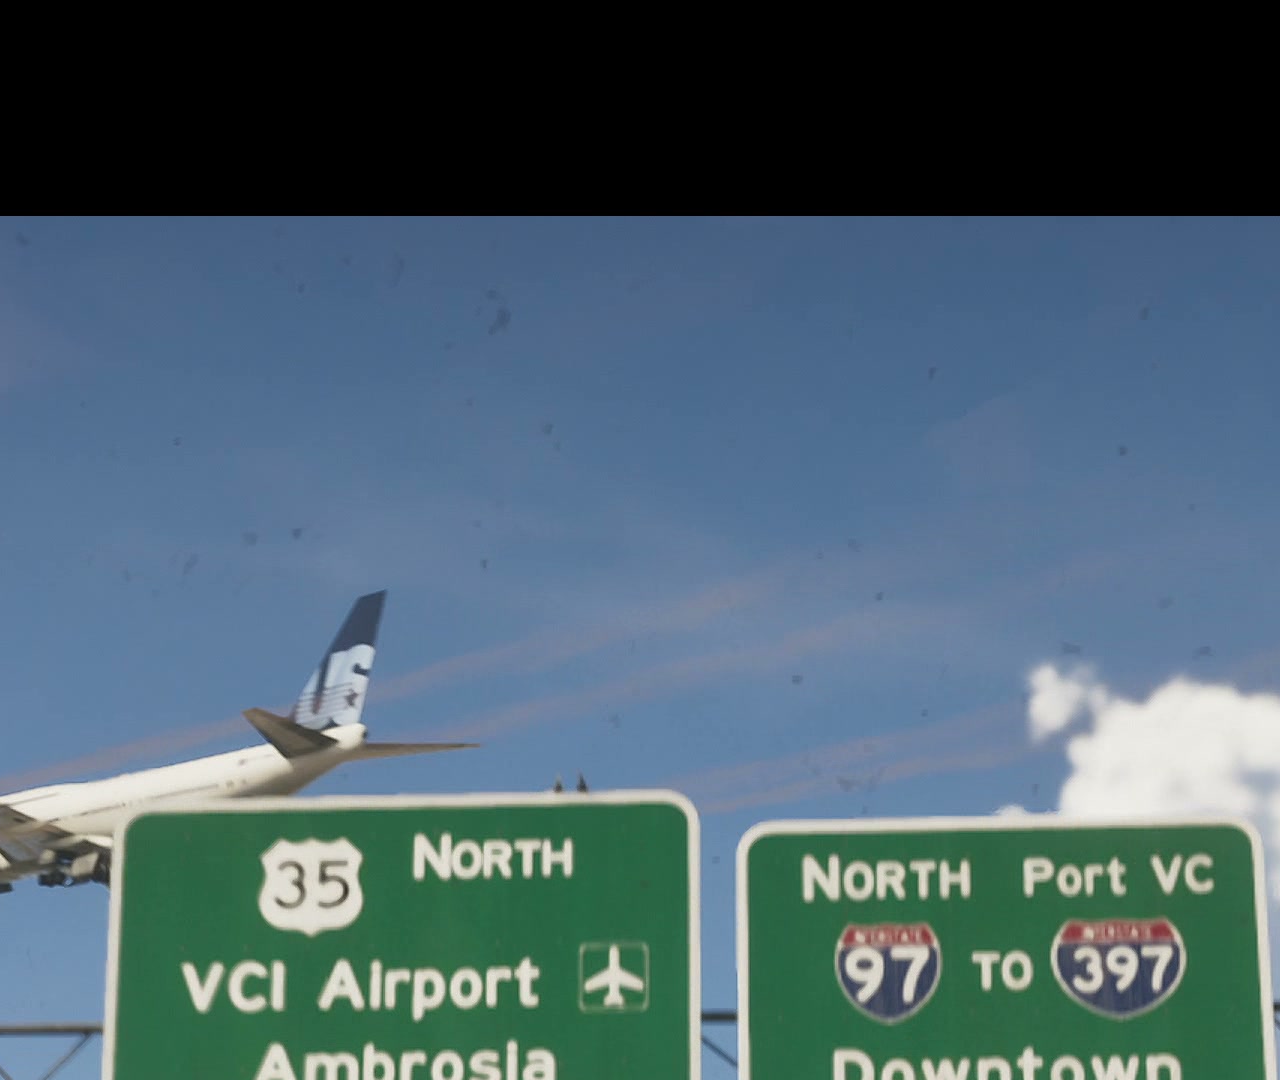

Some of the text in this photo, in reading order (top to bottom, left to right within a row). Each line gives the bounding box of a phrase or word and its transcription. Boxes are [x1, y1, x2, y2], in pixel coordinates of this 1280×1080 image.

[273, 832, 574, 910] 35 NORTH
[801, 853, 1215, 903] NORTH Port VC
[180, 956, 541, 1022] VCI Airport
[845, 944, 1173, 1003] 97 TO 397
